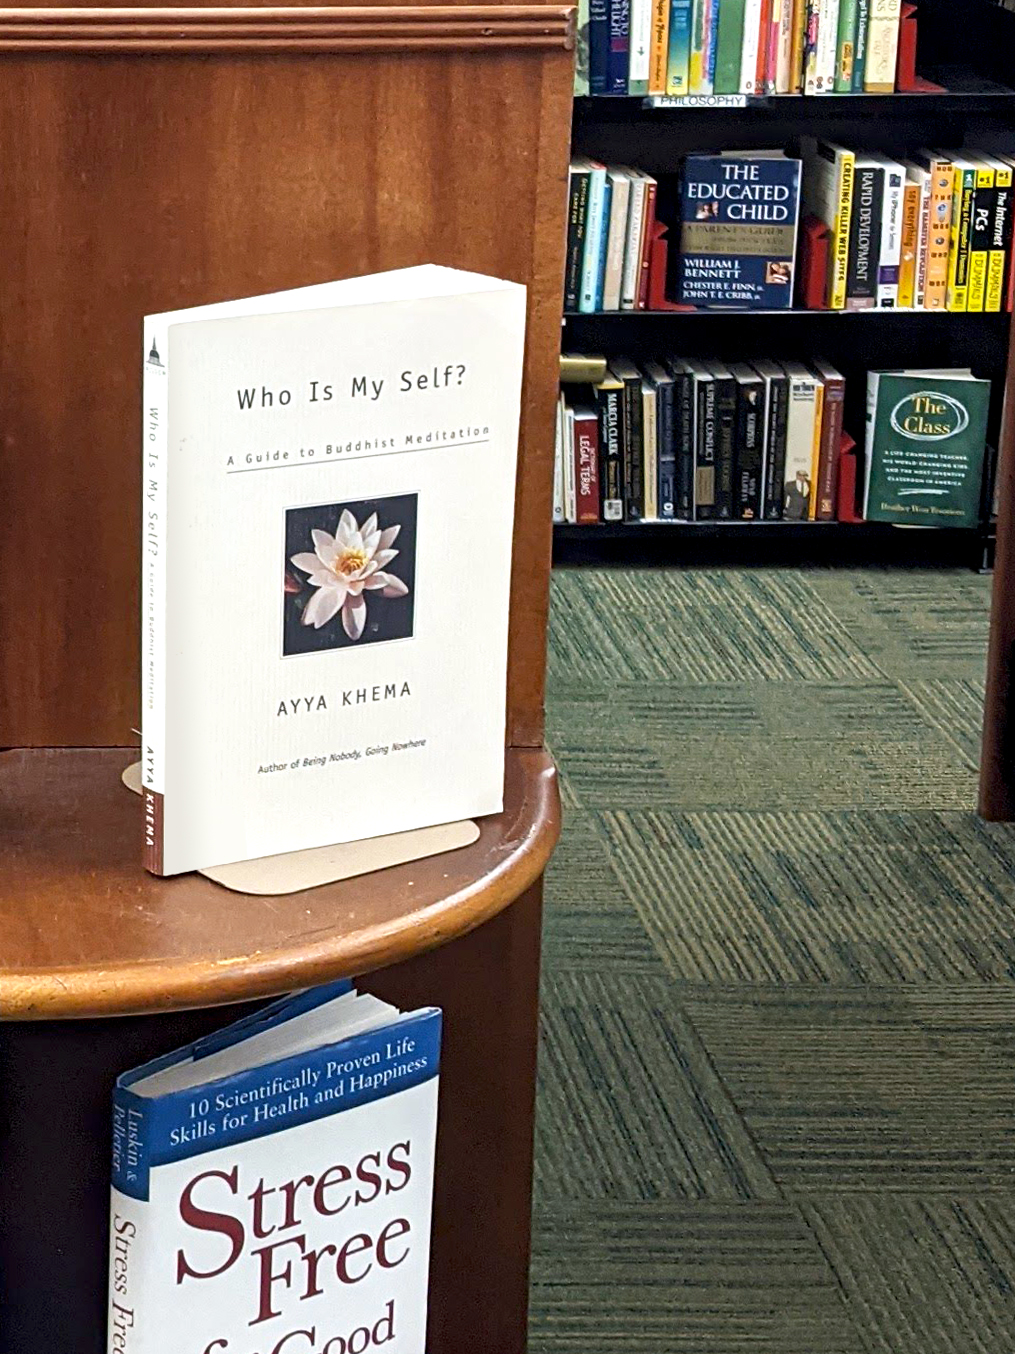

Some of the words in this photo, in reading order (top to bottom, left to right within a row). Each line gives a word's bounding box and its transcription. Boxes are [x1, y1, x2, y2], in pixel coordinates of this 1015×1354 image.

[661, 96, 743, 107] PHILOSOPHY
[721, 164, 759, 180] THE
[841, 162, 852, 204] CREATING
[860, 171, 874, 206] RAPID
[688, 182, 789, 201] EDUCATED
[997, 191, 1007, 206] The
[727, 203, 788, 220] CHILD
[840, 205, 850, 235] KILLER
[975, 208, 989, 231] PCs
[993, 206, 1006, 247] Internet
[839, 236, 848, 255] WEB
[855, 208, 872, 281] DEVELOPMENT
[684, 259, 731, 269] WILLIAM
[685, 269, 742, 279] BENNETT
[237, 386, 292, 410] Who
[309, 381, 333, 402] Is
[351, 375, 384, 400] My
[400, 363, 468, 392] Self?
[705, 383, 715, 419] SUPREME
[607, 392, 618, 426] MARCIA
[911, 396, 947, 414] The
[147, 406, 159, 443] Who
[608, 427, 619, 455] CLARK
[705, 421, 715, 462] CONFLICT
[904, 416, 951, 434] Class
[147, 451, 159, 472] Is
[227, 455, 235, 466] A
[245, 449, 290, 464] Guide
[300, 445, 316, 458] to
[325, 435, 396, 457] Buddhist
[405, 425, 490, 448] Meditation
[579, 435, 590, 463] LEGAL
[147, 478, 159, 502] My
[580, 466, 591, 496] TERMS
[276, 693, 329, 718] AYYA
[341, 680, 413, 708] KHEMA
[144, 746, 155, 784] AYYA
[257, 760, 288, 776] Author
[289, 758, 301, 771] of
[302, 752, 327, 770] Being
[329, 747, 362, 765] Nobody,
[365, 744, 389, 764] Going
[391, 738, 426, 756] Nowhere
[144, 793, 156, 847] KHEMA
[189, 1099, 210, 1118] 10
[215, 1068, 321, 1113] Scientifically
[326, 1052, 382, 1078] Proven
[385, 1036, 416, 1060] Life
[170, 1120, 216, 1147] Skills
[222, 1112, 249, 1131] for
[253, 1095, 310, 1123] Health
[314, 1080, 345, 1104] and
[349, 1056, 429, 1093] Happiness
[127, 1108, 145, 1165] Luskin
[175, 1139, 413, 1286] Stress
[112, 1213, 137, 1295] Stress
[247, 1217, 412, 1327] Free
